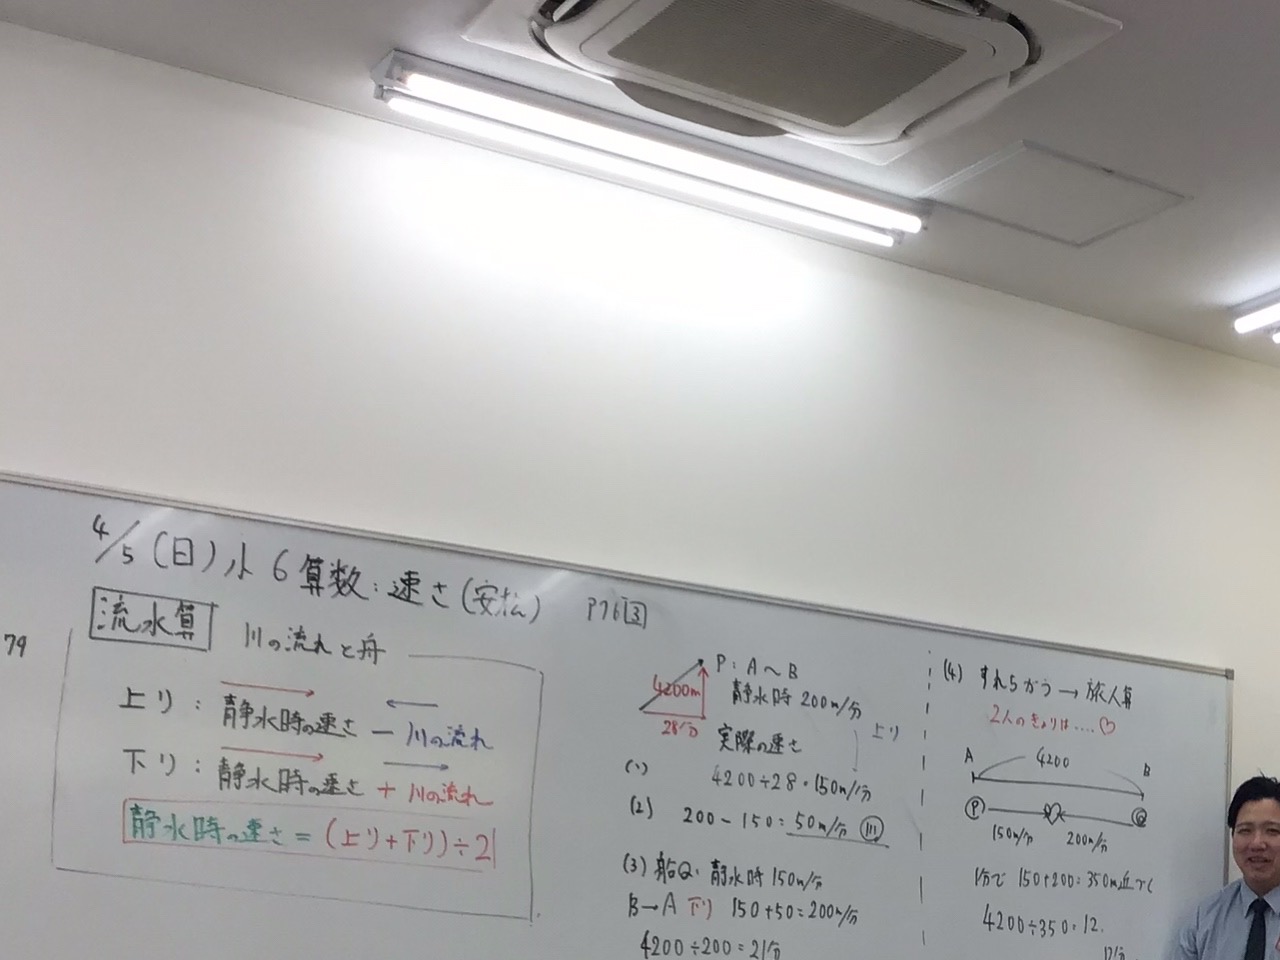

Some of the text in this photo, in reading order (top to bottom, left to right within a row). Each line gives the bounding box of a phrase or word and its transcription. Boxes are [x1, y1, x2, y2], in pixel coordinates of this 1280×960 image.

[96, 594, 195, 641] 流水算
[4, 633, 27, 658] 79
